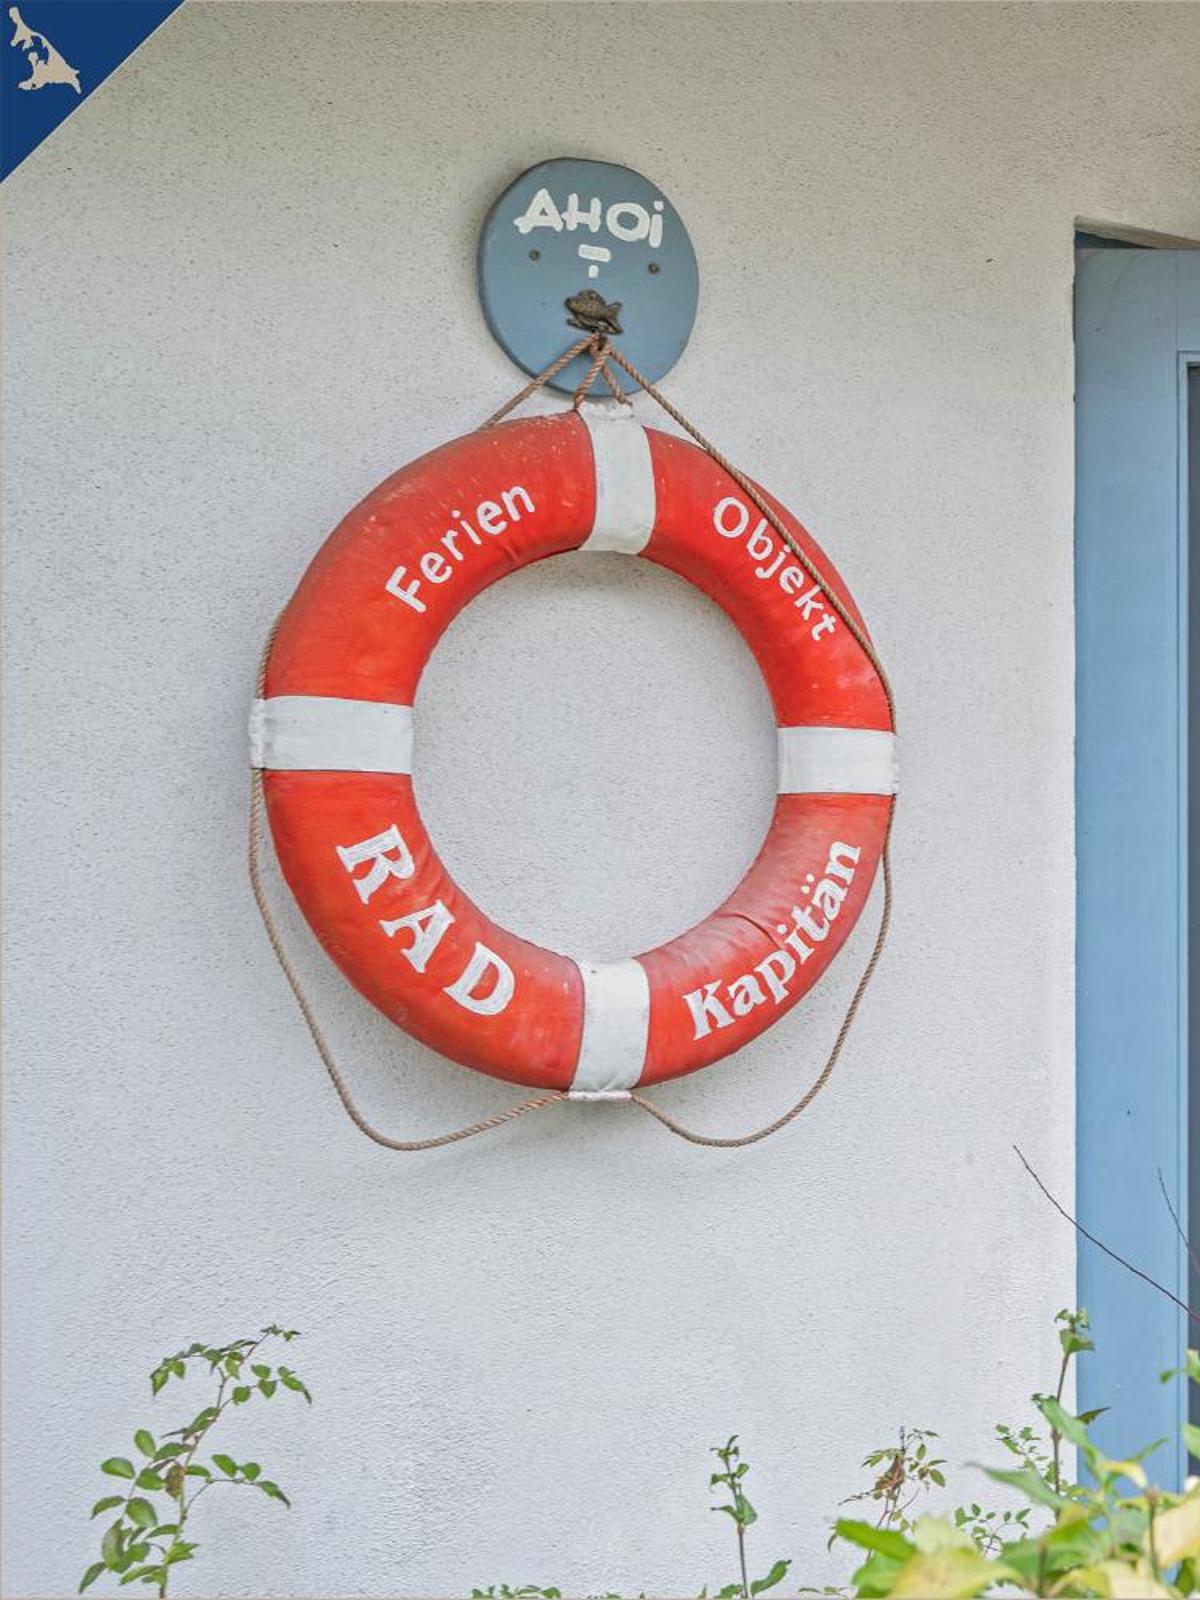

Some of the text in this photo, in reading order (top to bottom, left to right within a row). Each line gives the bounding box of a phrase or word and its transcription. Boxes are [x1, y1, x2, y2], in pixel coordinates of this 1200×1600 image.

[385, 484, 838, 642] Ferien Objekt
[336, 823, 863, 1041] RAD Kapitän
